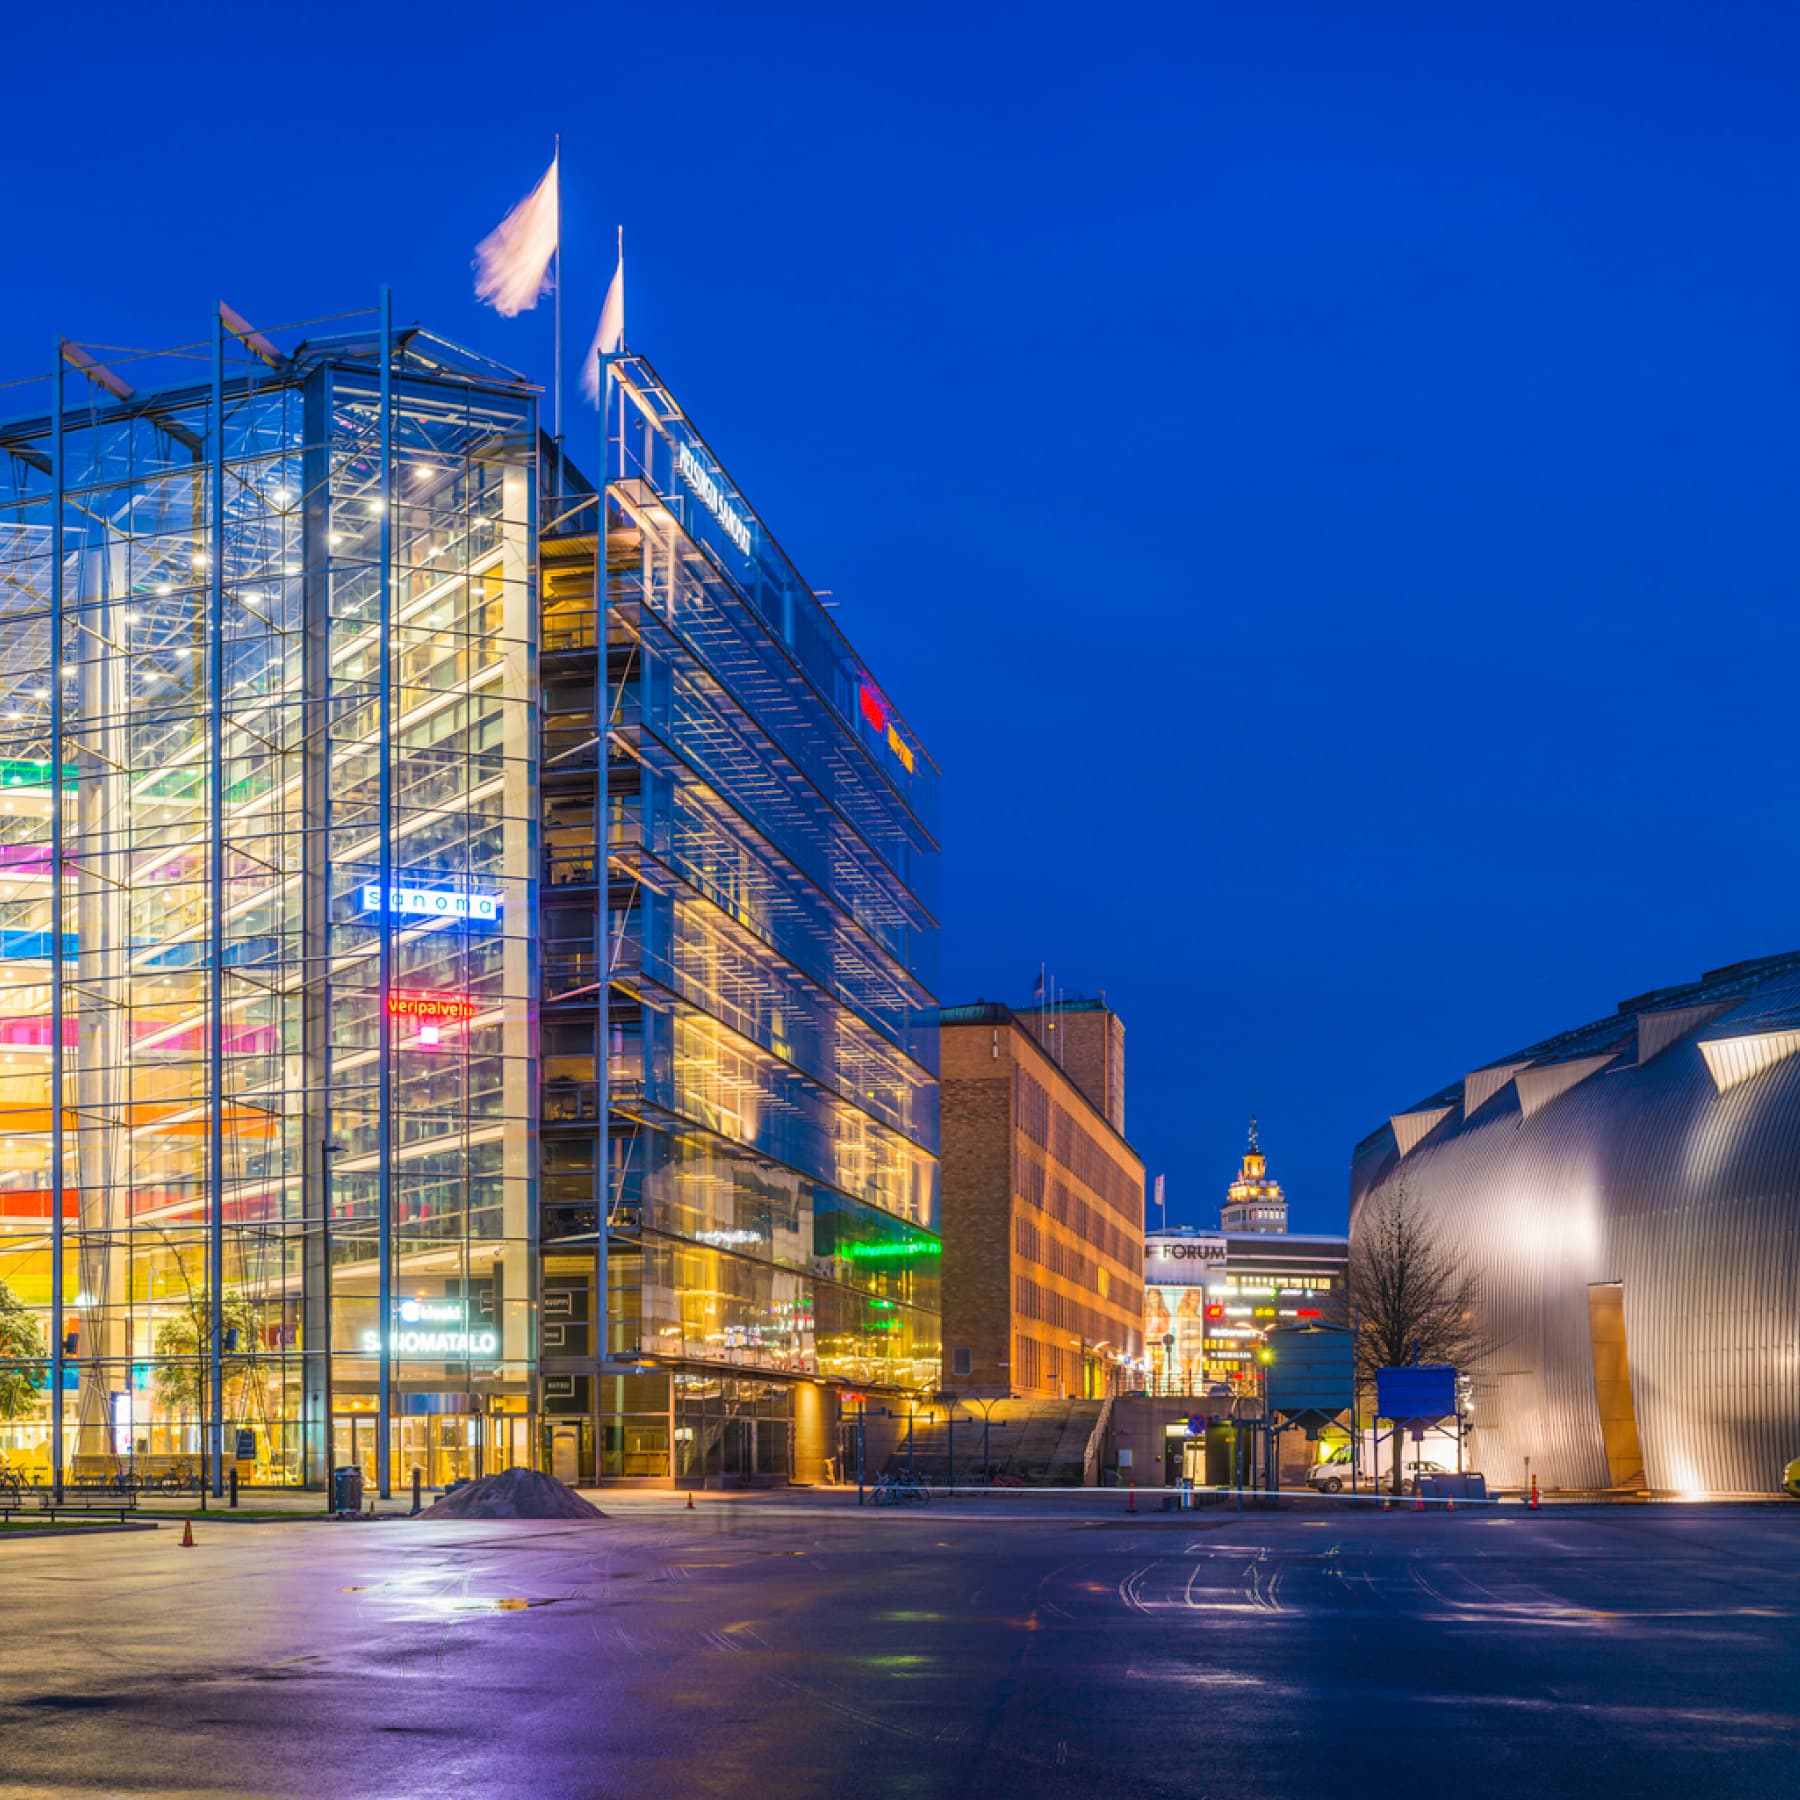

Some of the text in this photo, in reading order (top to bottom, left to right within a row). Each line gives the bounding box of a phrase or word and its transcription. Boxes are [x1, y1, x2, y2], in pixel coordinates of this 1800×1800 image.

[368, 890, 492, 914] sanoma
[1163, 1244, 1225, 1260] FORUM
[363, 1331, 496, 1352] SNOMATALO
